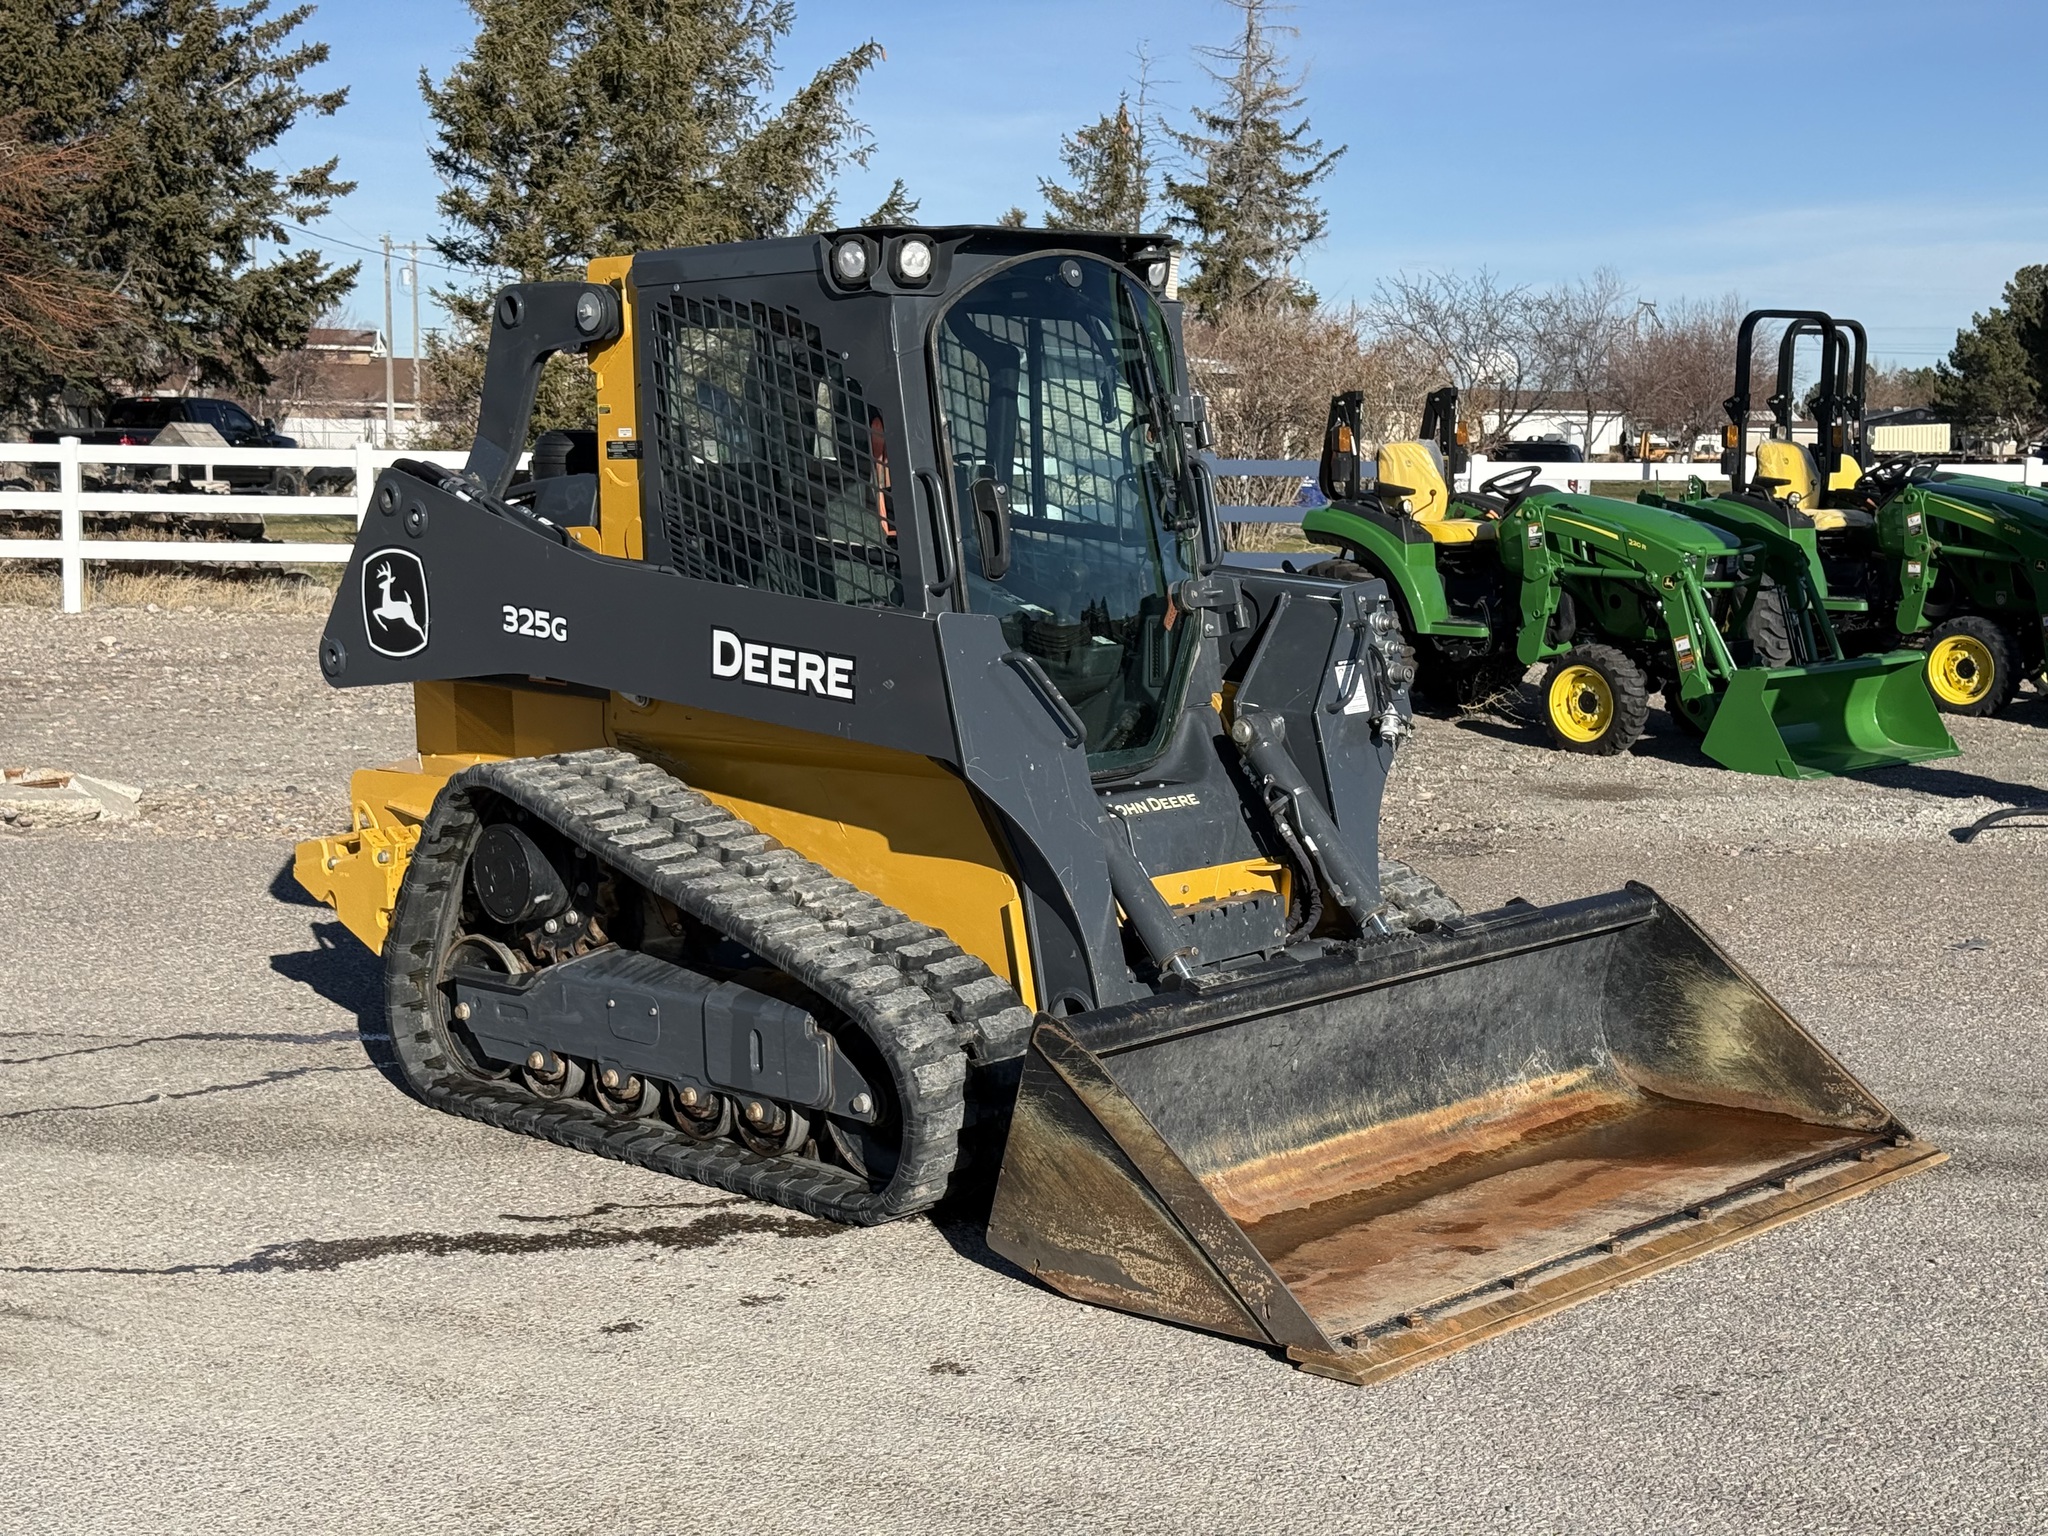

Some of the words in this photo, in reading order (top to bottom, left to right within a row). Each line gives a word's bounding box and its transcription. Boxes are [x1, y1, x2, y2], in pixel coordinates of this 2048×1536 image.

[502, 604, 568, 642] 325G
[712, 629, 854, 700] DEERE
[1146, 793, 1201, 812] DEERE
